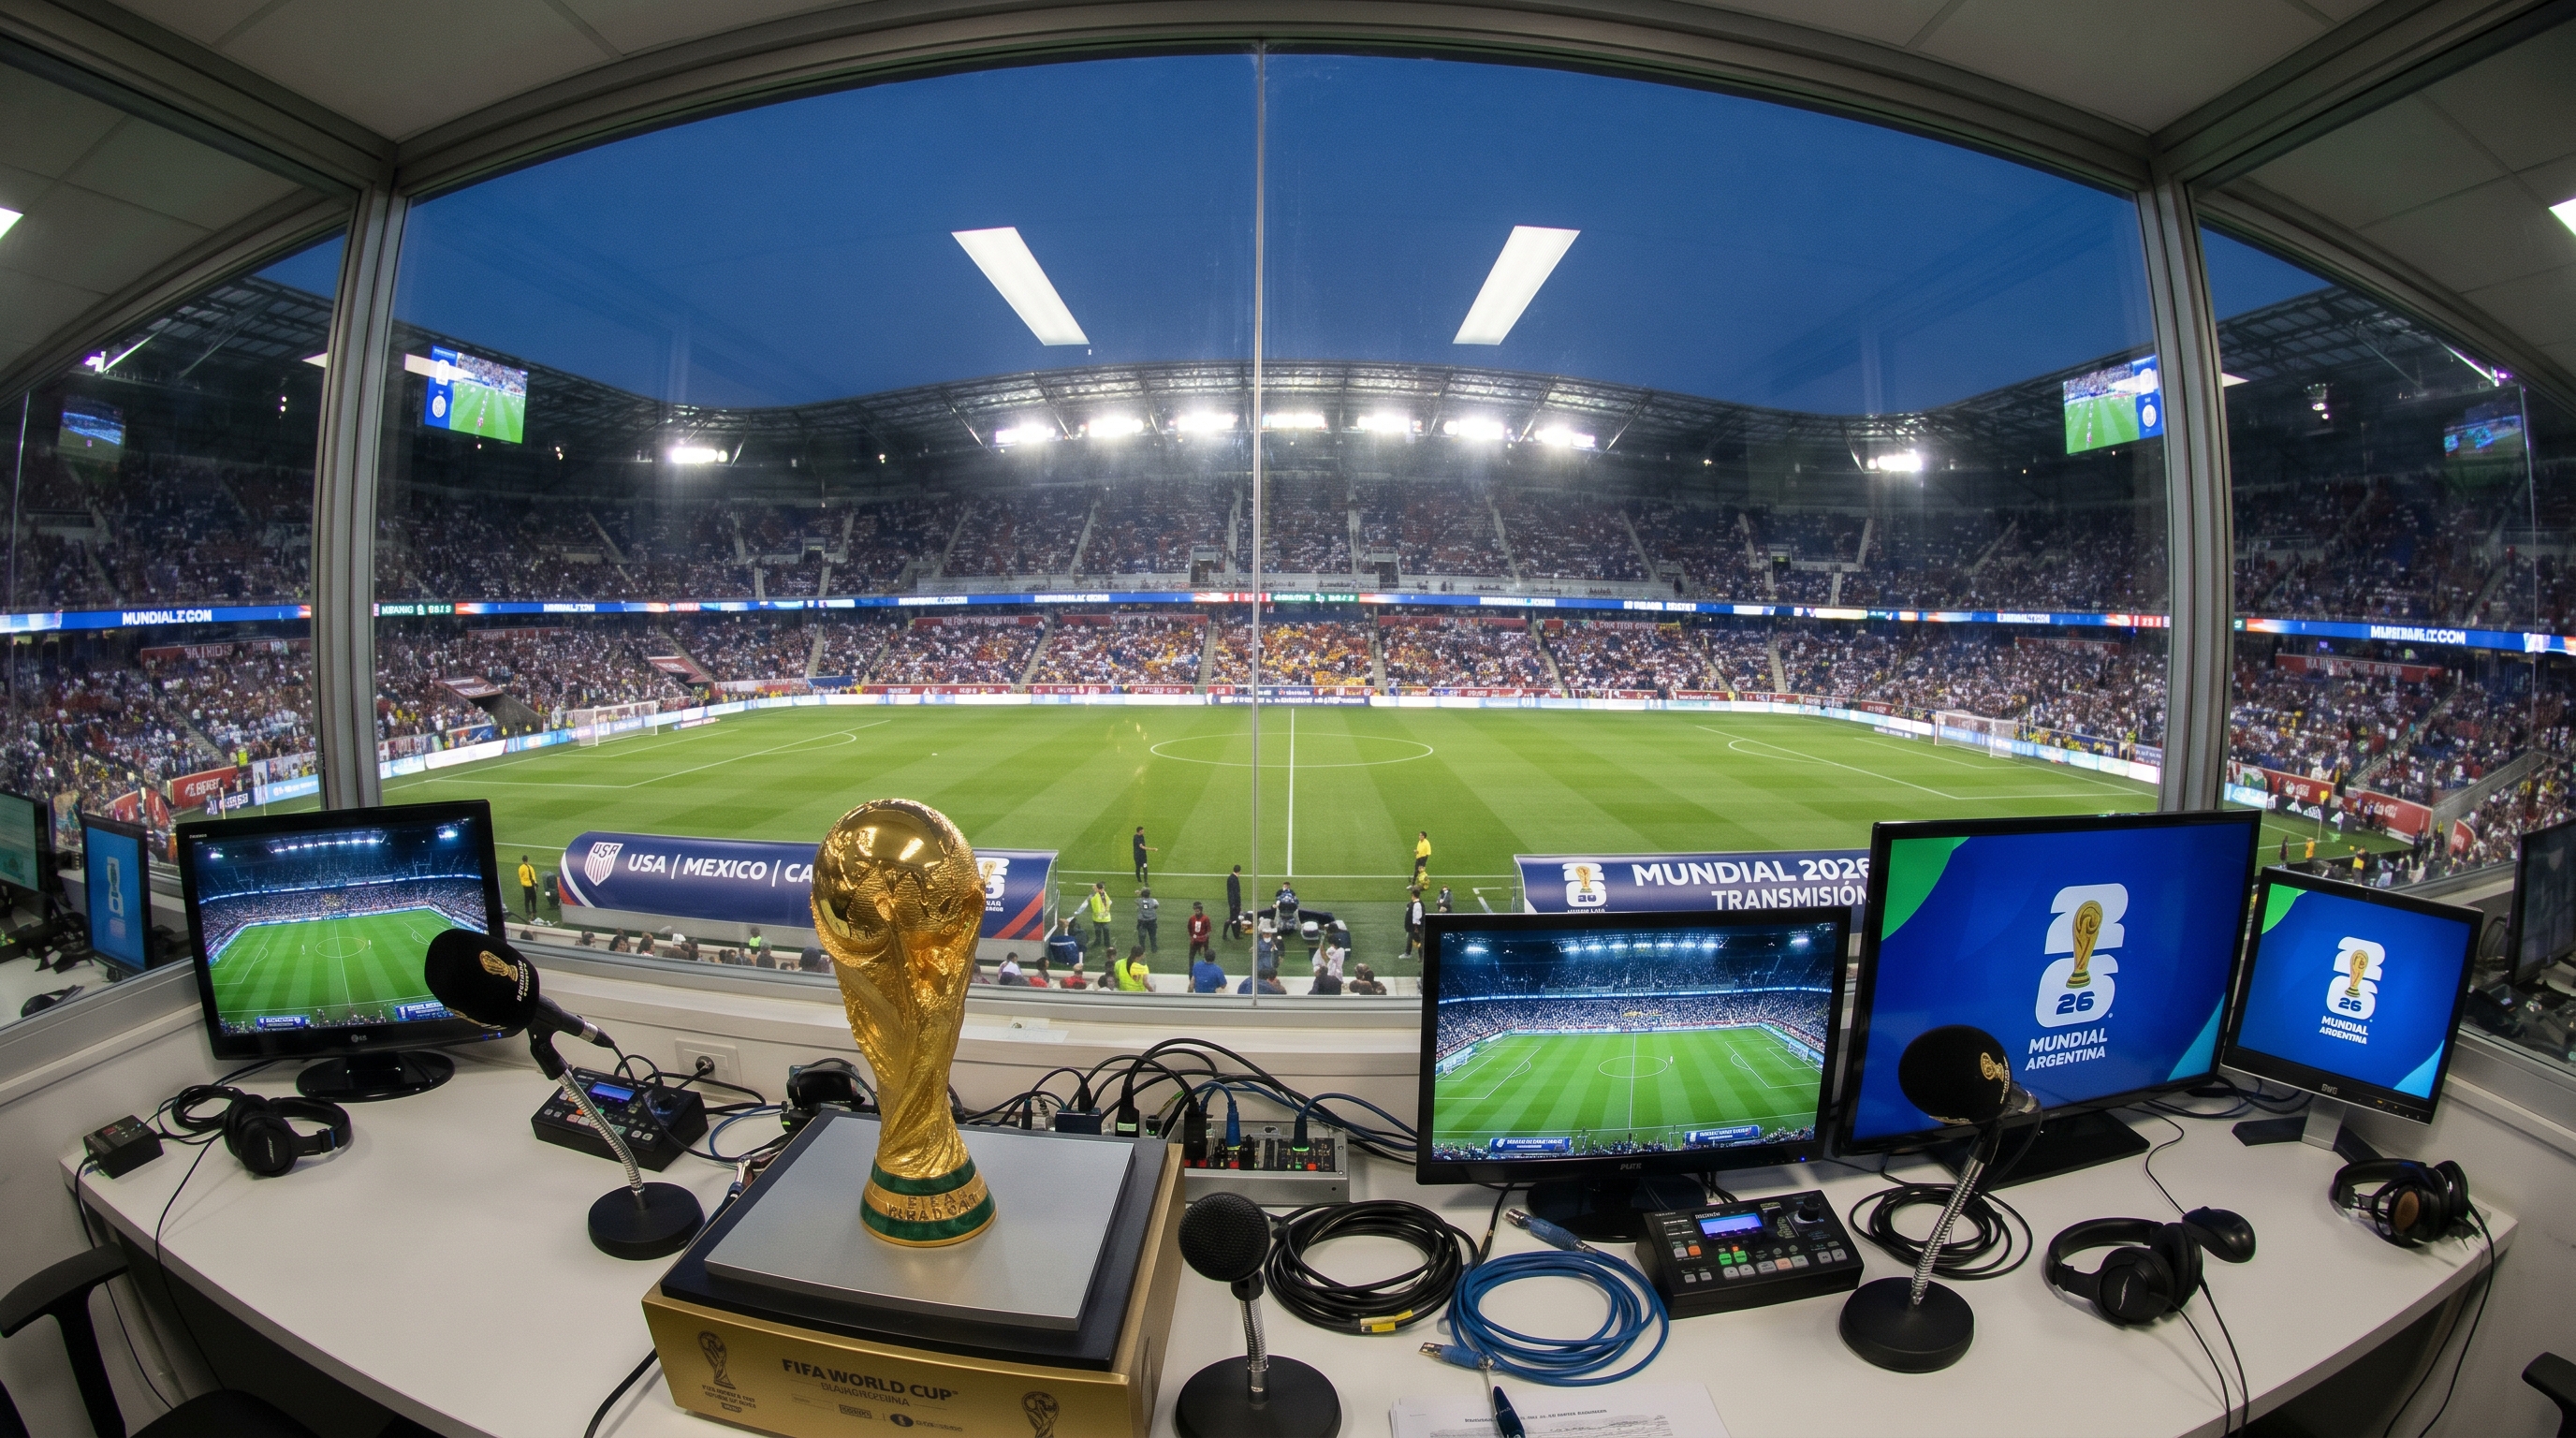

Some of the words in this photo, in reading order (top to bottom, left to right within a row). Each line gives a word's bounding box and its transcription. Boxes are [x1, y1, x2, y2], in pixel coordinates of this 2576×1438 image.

[593, 844, 620, 858] USA
[627, 853, 666, 873] USA
[682, 857, 768, 881] MEXICO
[1632, 859, 1797, 887] MUNDIAL
[2056, 990, 2096, 1016] 26
[2337, 997, 2363, 1012] 26
[2320, 1015, 2369, 1036] MUNDIAL
[2027, 1027, 2108, 1055] MUNDIAL
[2025, 1045, 2106, 1072] ARGENTINA
[782, 1358, 827, 1380] FIFA
[827, 1368, 905, 1394] WORLD
